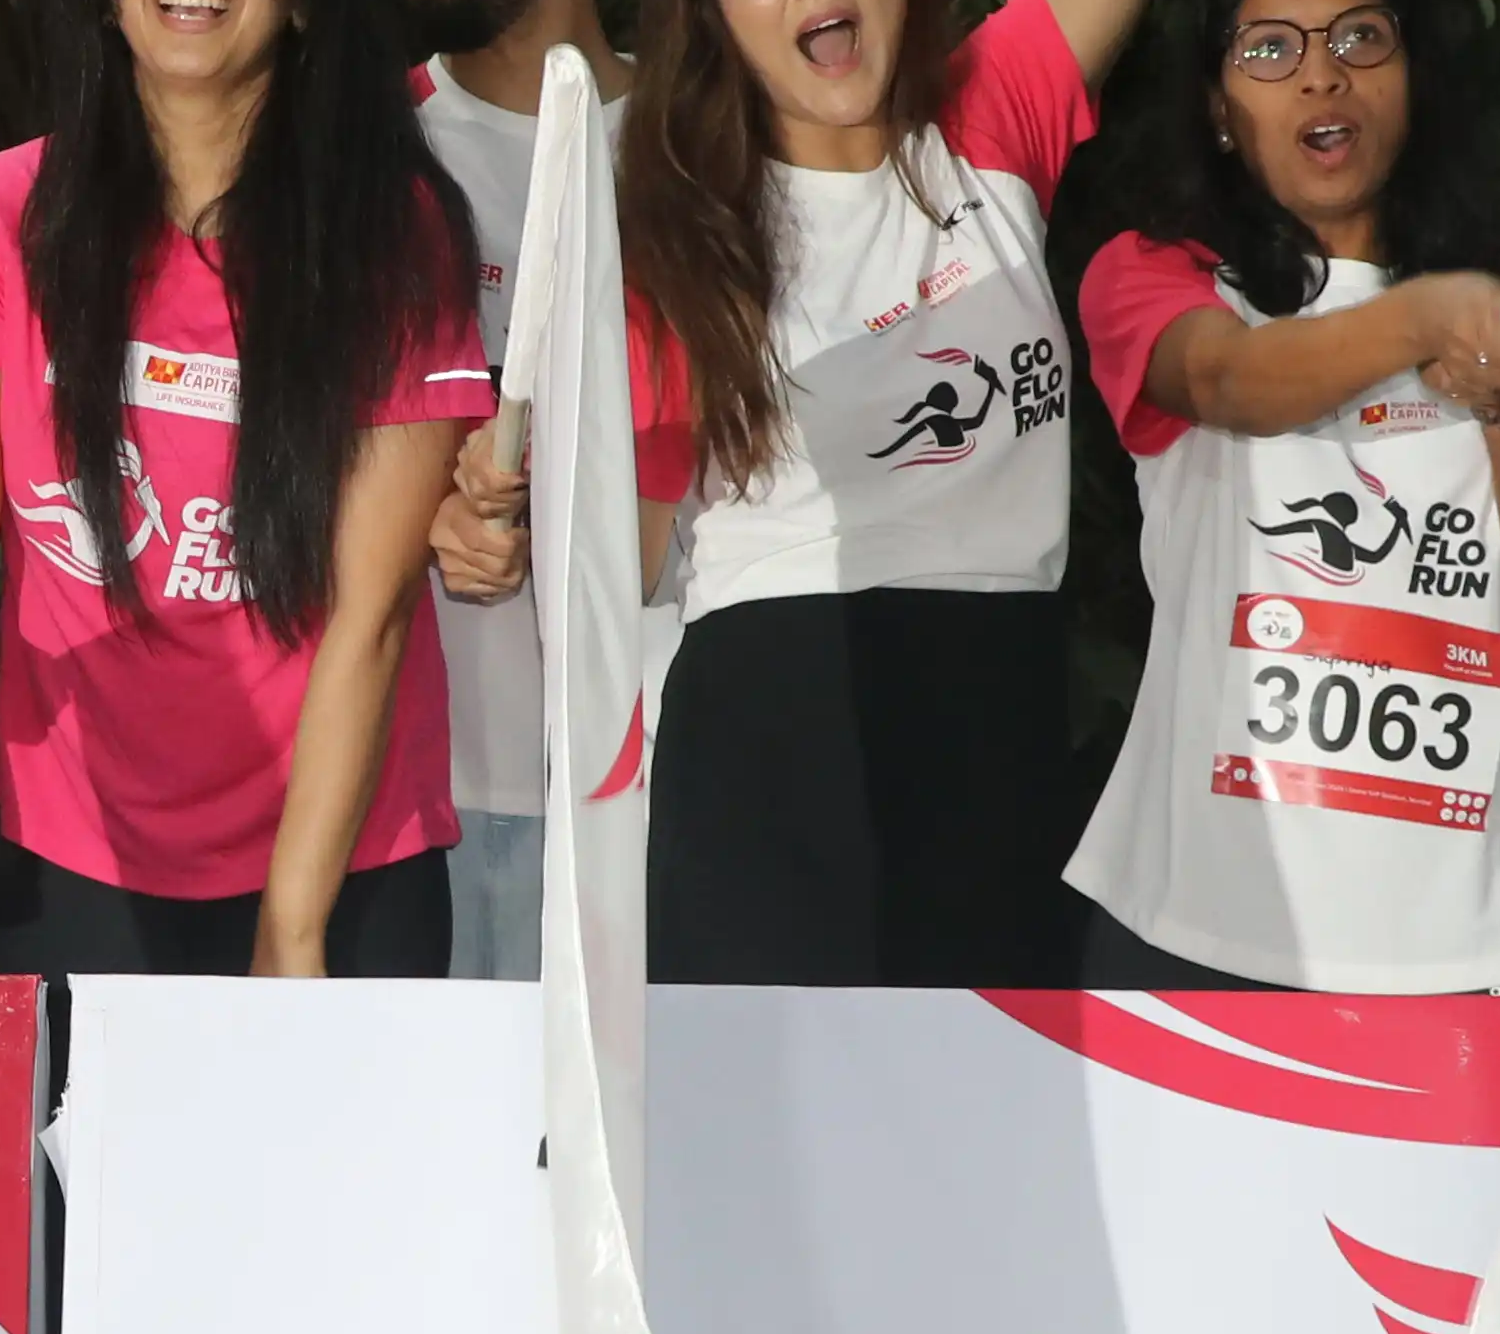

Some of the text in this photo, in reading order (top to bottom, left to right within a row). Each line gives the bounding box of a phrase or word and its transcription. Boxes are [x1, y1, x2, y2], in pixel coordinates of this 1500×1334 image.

[480, 263, 503, 284] ER
[930, 262, 971, 295] CAPITAL
[187, 362, 240, 379] ADITYA BIR
[1011, 337, 1053, 375] GO
[183, 373, 240, 395] CAPITA
[1013, 364, 1062, 407] FLO
[156, 392, 226, 411] LIFE INSURANCE
[1014, 391, 1065, 437] RUN
[1390, 409, 1440, 419] CAPITAL
[1425, 501, 1475, 535] GO
[1415, 533, 1486, 567] FLO
[1408, 564, 1490, 599] RUN
[1446, 643, 1488, 667] 3KM
[1247, 664, 1473, 772] 3063
